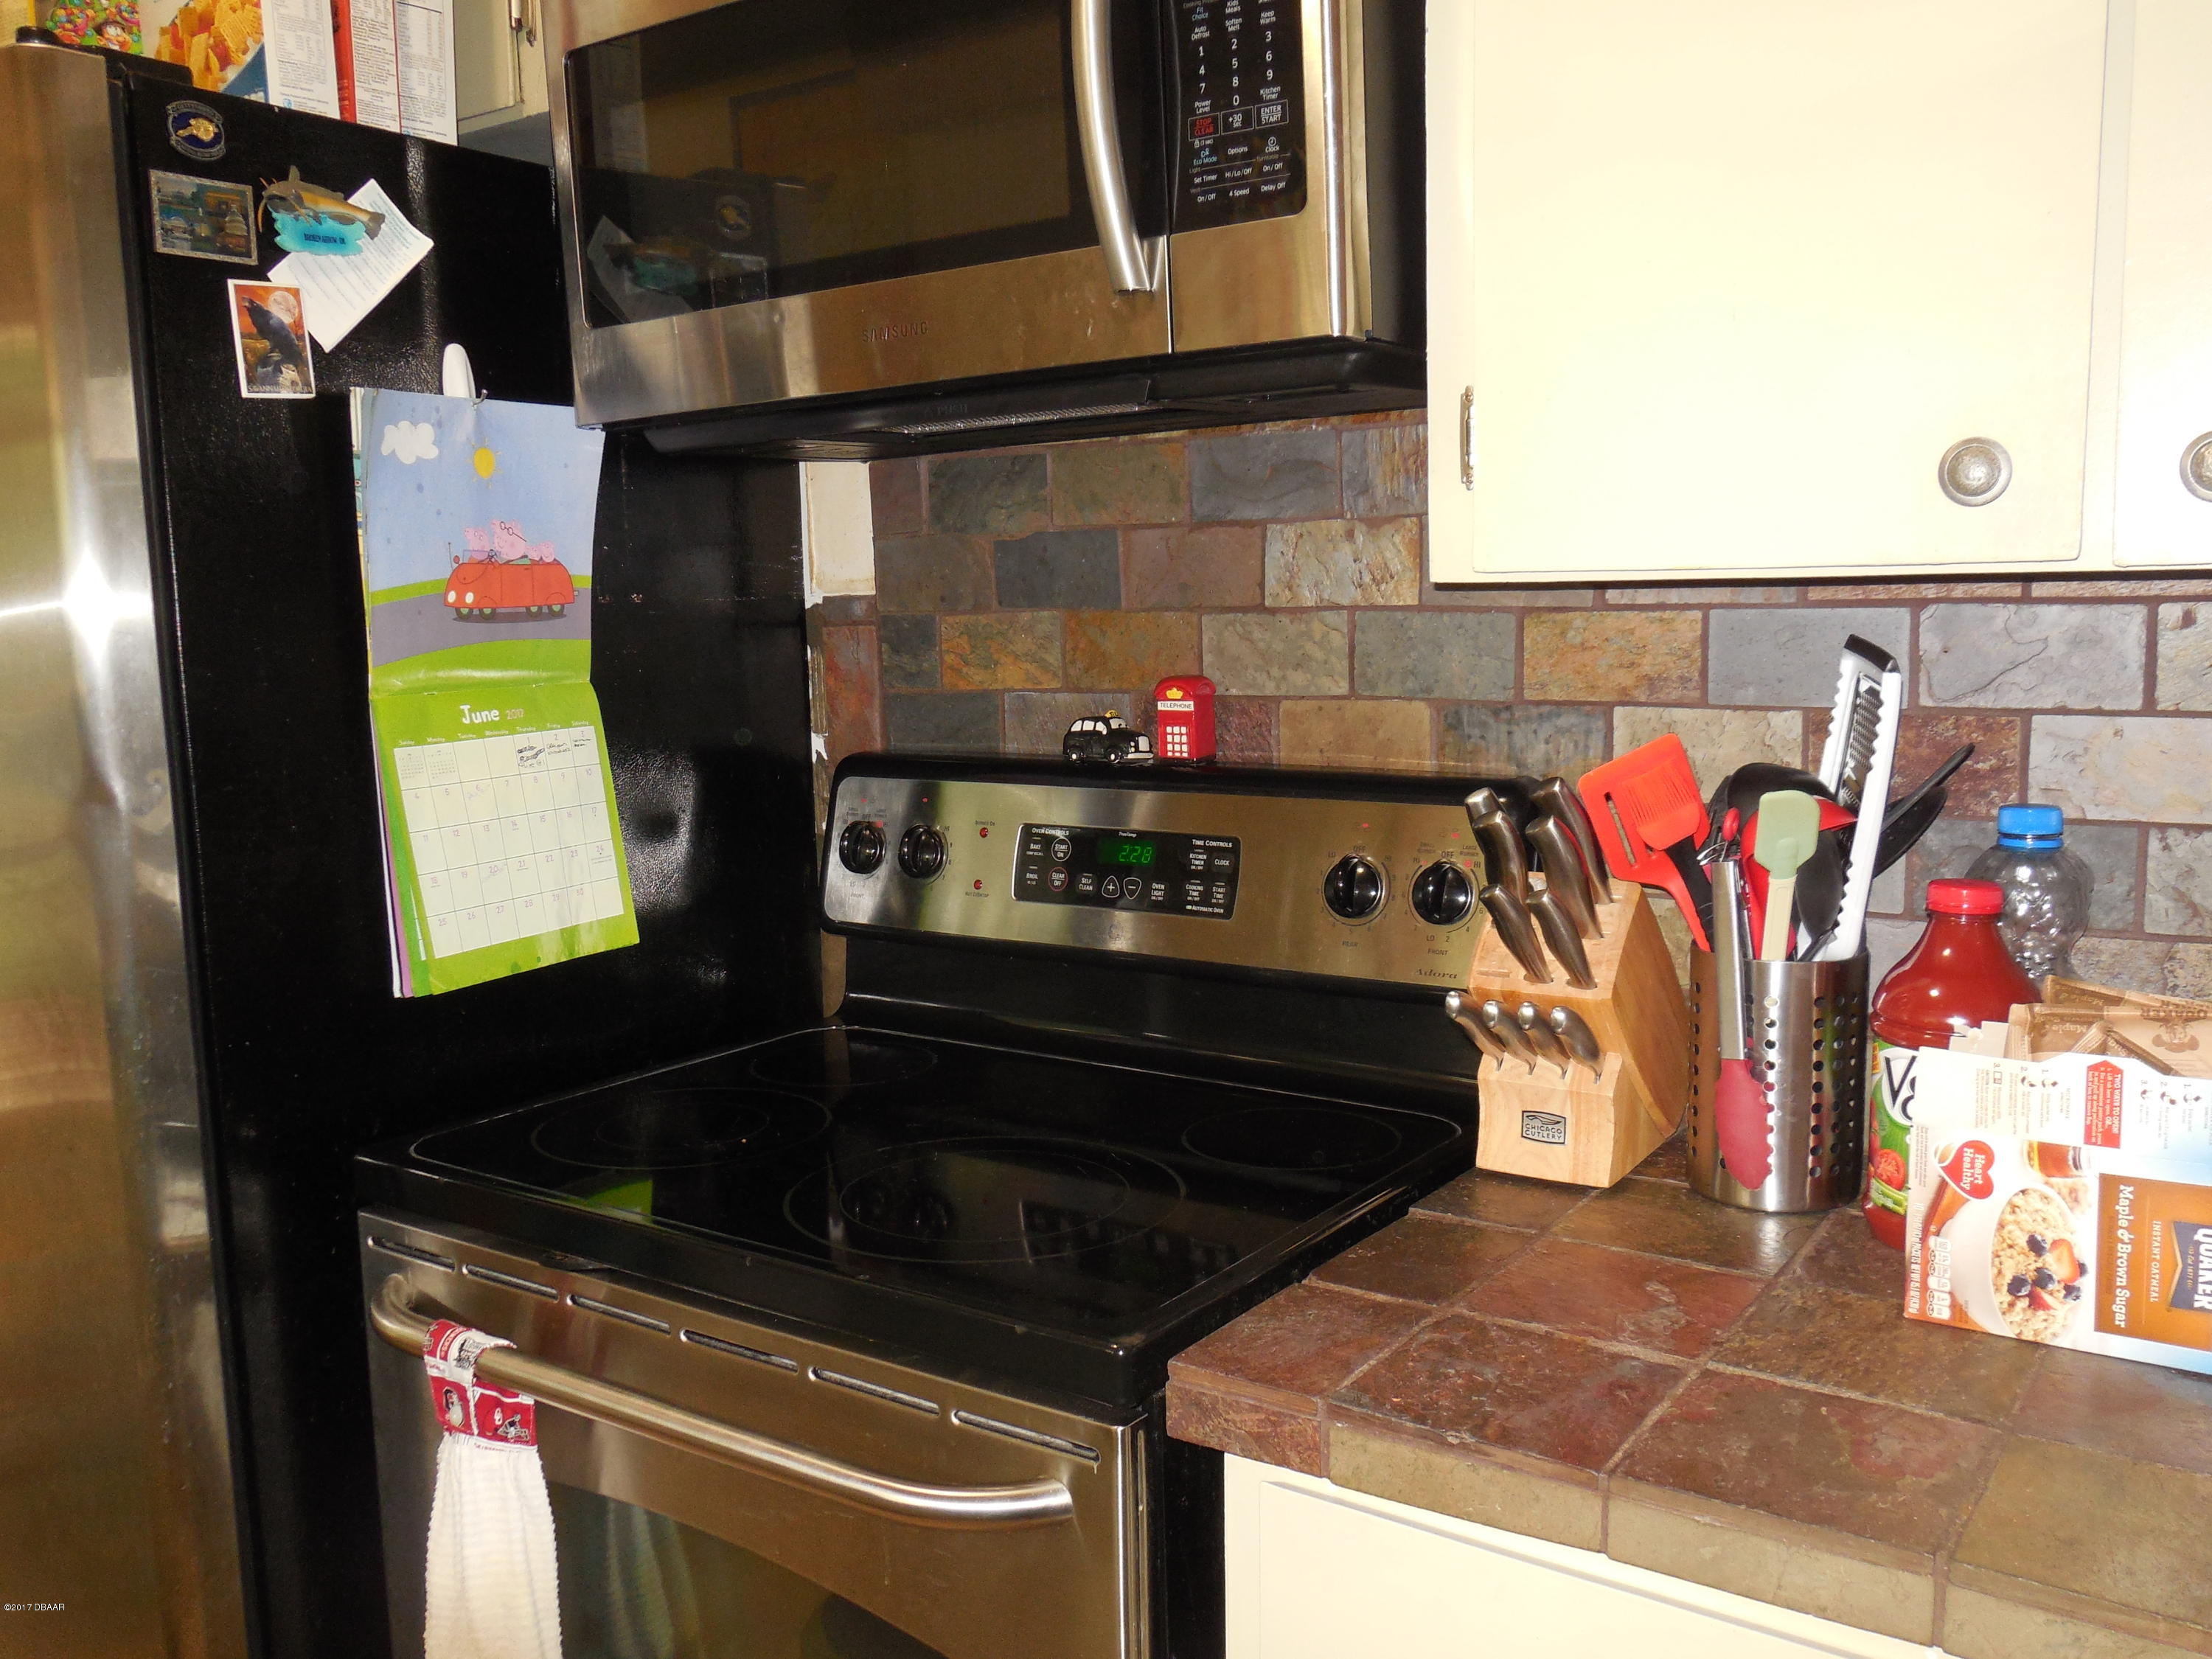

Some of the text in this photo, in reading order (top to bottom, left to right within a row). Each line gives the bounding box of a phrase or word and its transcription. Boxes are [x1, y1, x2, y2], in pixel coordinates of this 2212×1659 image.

[1225, 6, 1241, 14] Meals
[1260, 10, 1275, 18] Keep
[1192, 13, 1209, 21] Choice
[1225, 17, 1242, 27] Soften
[1260, 16, 1276, 25] Warm
[1228, 24, 1240, 32] Melt
[1192, 31, 1210, 41] Defrost
[1265, 31, 1272, 41] 3
[1231, 38, 1238, 50] 2
[1199, 46, 1204, 57] 1
[1265, 51, 1273, 62] 6
[1231, 58, 1239, 69] 5
[1199, 65, 1206, 75] 4
[1267, 69, 1273, 81] 9
[1233, 77, 1239, 87] 8
[1199, 83, 1206, 94] 7
[1259, 86, 1281, 96] Kitchen
[1194, 100, 1211, 108] Power
[1233, 94, 1239, 106] 0
[1196, 106, 1211, 114] Level
[1261, 105, 1281, 115] ENTER
[1196, 118, 1212, 127] STOP
[1228, 114, 1242, 122] +30
[1261, 114, 1281, 125] START
[1233, 120, 1242, 128] sec
[1194, 125, 1214, 136] CLEAR
[1227, 146, 1248, 155] Options
[1265, 145, 1280, 153] Clock
[1193, 155, 1217, 165] Eco Mode
[1203, 174, 1217, 182] Timer
[1261, 181, 1286, 192] Delay Off
[1234, 187, 1250, 197] Speed
[459, 704, 500, 724] June
[453, 830, 460, 838] 12
[571, 850, 579, 858] 23
[1118, 845, 1153, 863] 2:28
[1441, 851, 1454, 859] OFF
[1214, 858, 1230, 866] CLOCK
[466, 911, 476, 920] 26
[1427, 948, 1448, 956] FRONT
[1416, 969, 1458, 979] Adora
[2052, 1024, 2087, 1033] Maple
[2113, 1074, 2121, 1088] TWO
[2113, 1106, 2121, 1116] TO
[1525, 1123, 1562, 1135] CHICAGO
[2112, 1116, 2120, 1134] OPEN!
[1525, 1130, 1562, 1141] CUTLERY
[1960, 1147, 1975, 1191] Healthy
[1974, 1153, 1986, 1184] Heart
[2112, 1184, 2135, 1328] Maple & Brown Sugar
[2150, 1220, 2162, 1303] INSTANT OATMEAL
